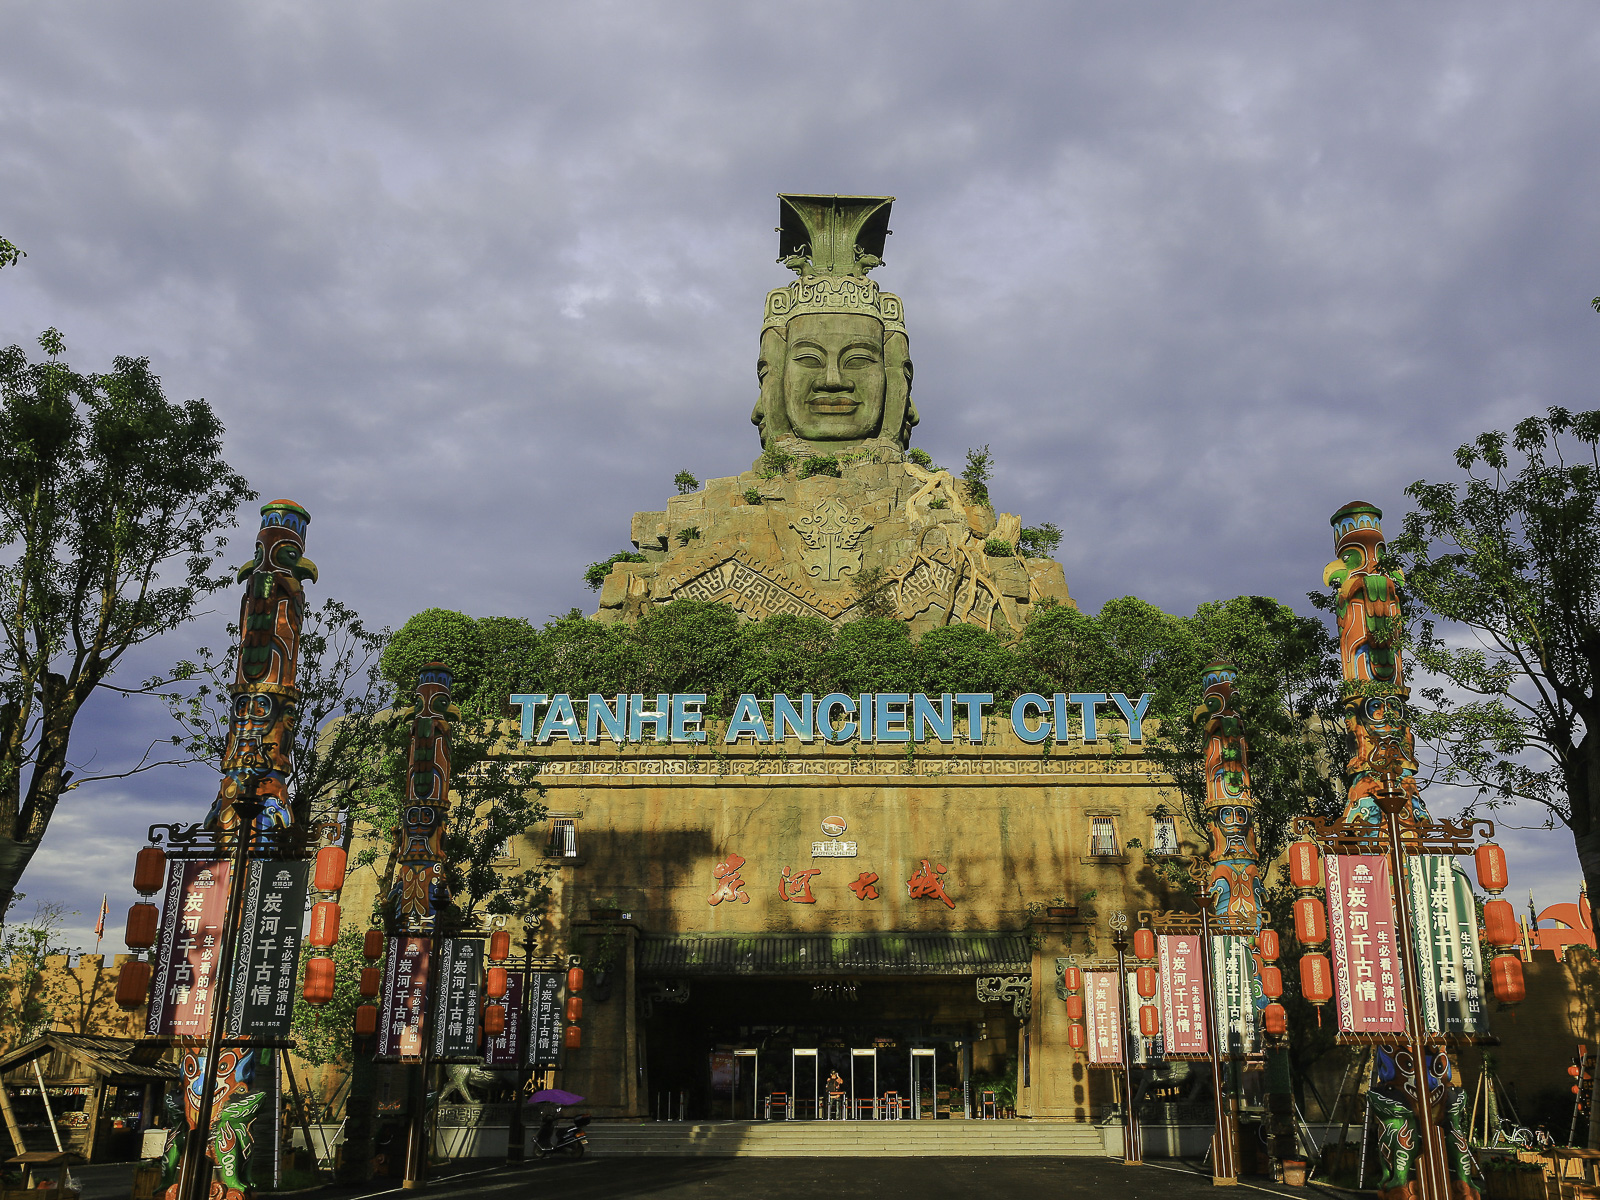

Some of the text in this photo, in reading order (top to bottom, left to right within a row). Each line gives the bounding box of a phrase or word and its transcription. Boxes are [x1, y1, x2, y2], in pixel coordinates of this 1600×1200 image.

[509, 693, 1153, 744] TANHE ANCIENT CITY
[707, 853, 956, 910] 炭河古城
[169, 891, 205, 1006] 炭河千古情
[193, 925, 218, 1016] 一生必看的演出
[250, 892, 283, 1006] 炭河千古情
[275, 926, 297, 1017] 一生必看的演出
[1347, 887, 1377, 1002] 炭河千古情
[1375, 921, 1397, 1013] 一生必看的演出
[1430, 887, 1460, 1002] 炭河千古情
[1458, 922, 1481, 1013] 一生必看的演出
[392, 959, 413, 1036] 炭河千古情
[409, 981, 423, 1043] 一生必看的演出
[448, 960, 468, 1037] 炭河千古情
[465, 982, 477, 1044] 一生必看的演出
[537, 990, 553, 1050] 炭河千古情
[1095, 989, 1109, 1048] 炭河千古情
[1172, 957, 1191, 1033] 炭河千古情
[1191, 979, 1203, 1040] 一生必看的演出
[1225, 957, 1241, 1033] 炭河千古情
